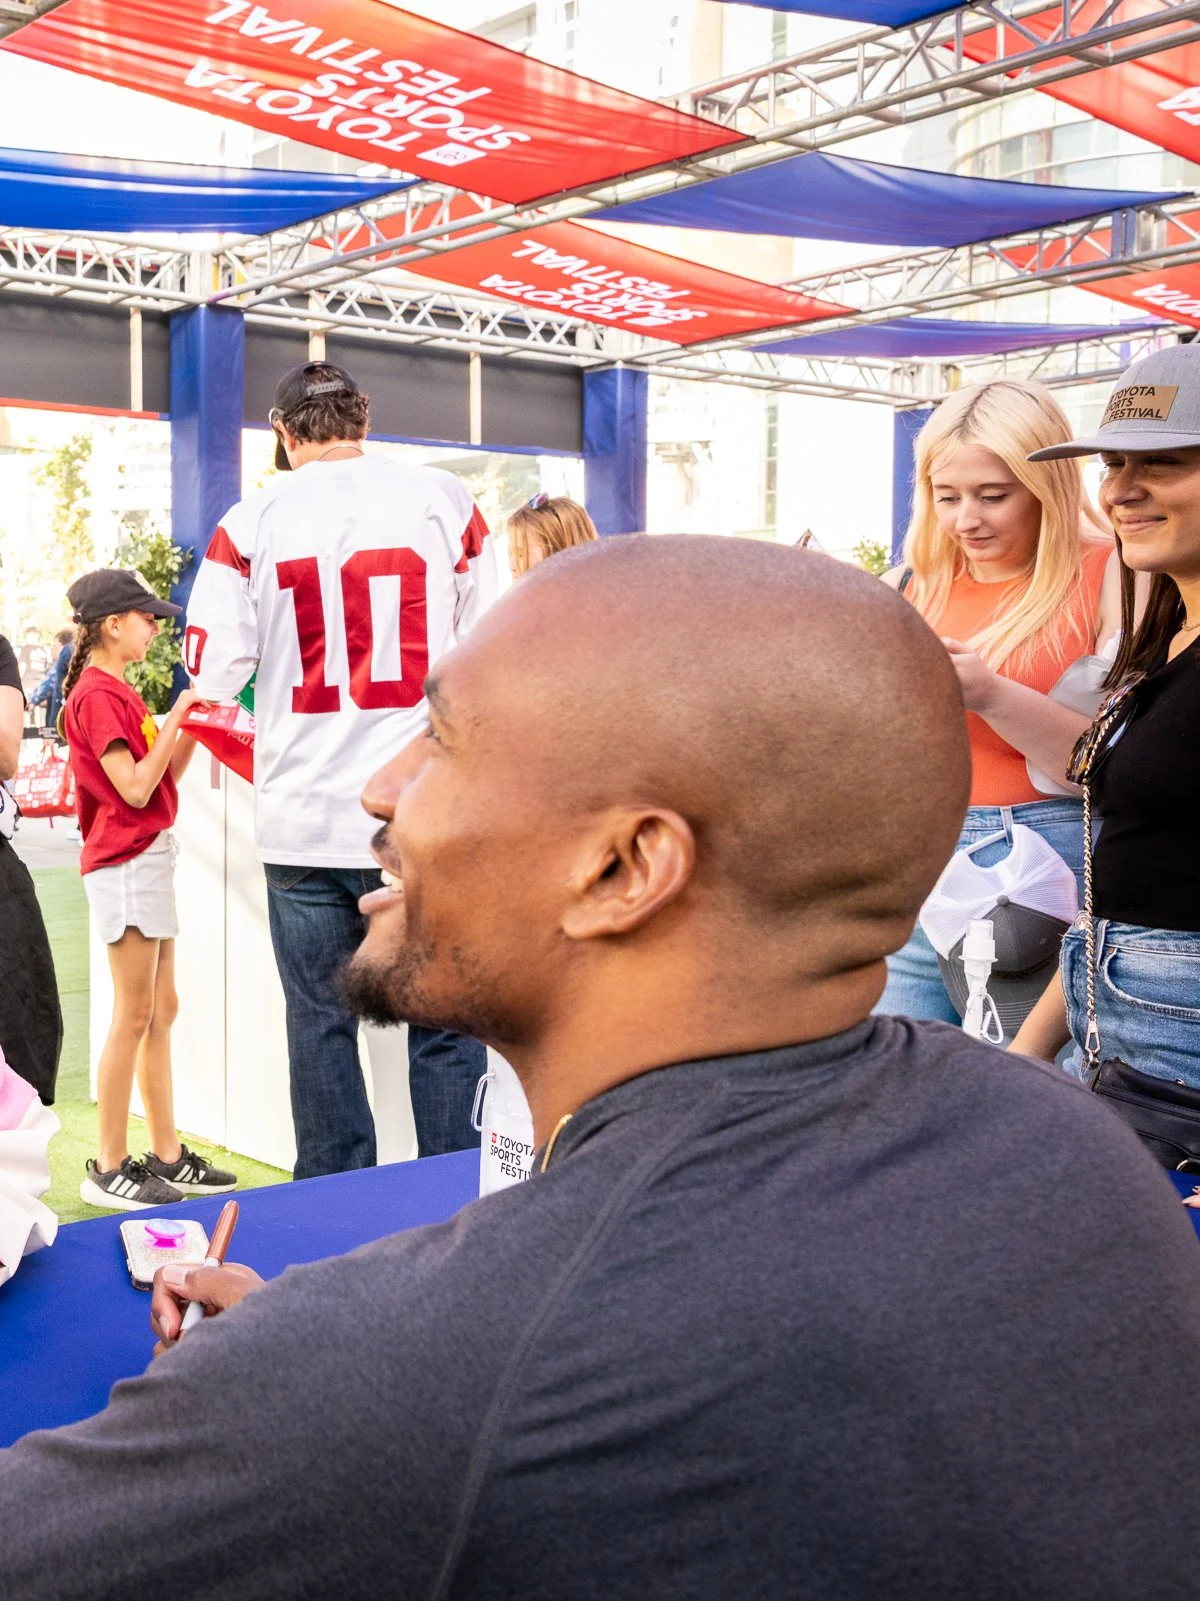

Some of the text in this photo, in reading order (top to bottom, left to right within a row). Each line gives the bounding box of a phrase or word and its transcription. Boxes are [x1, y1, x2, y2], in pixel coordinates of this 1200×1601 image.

[205, 0, 492, 107] FESTIVAL
[184, 57, 422, 152] TOYOTA
[302, 73, 532, 150] SPORTS
[511, 239, 691, 299] FESTIVAL
[479, 273, 632, 320] TOYOTA
[557, 282, 708, 321] SPORTS
[1104, 397, 1134, 416] PORTS
[1109, 408, 1163, 421] FESTIVAL
[1113, 386, 1155, 401] TOYOTA
[276, 547, 430, 714] 10
[490, 1144, 521, 1166] SPORTS
